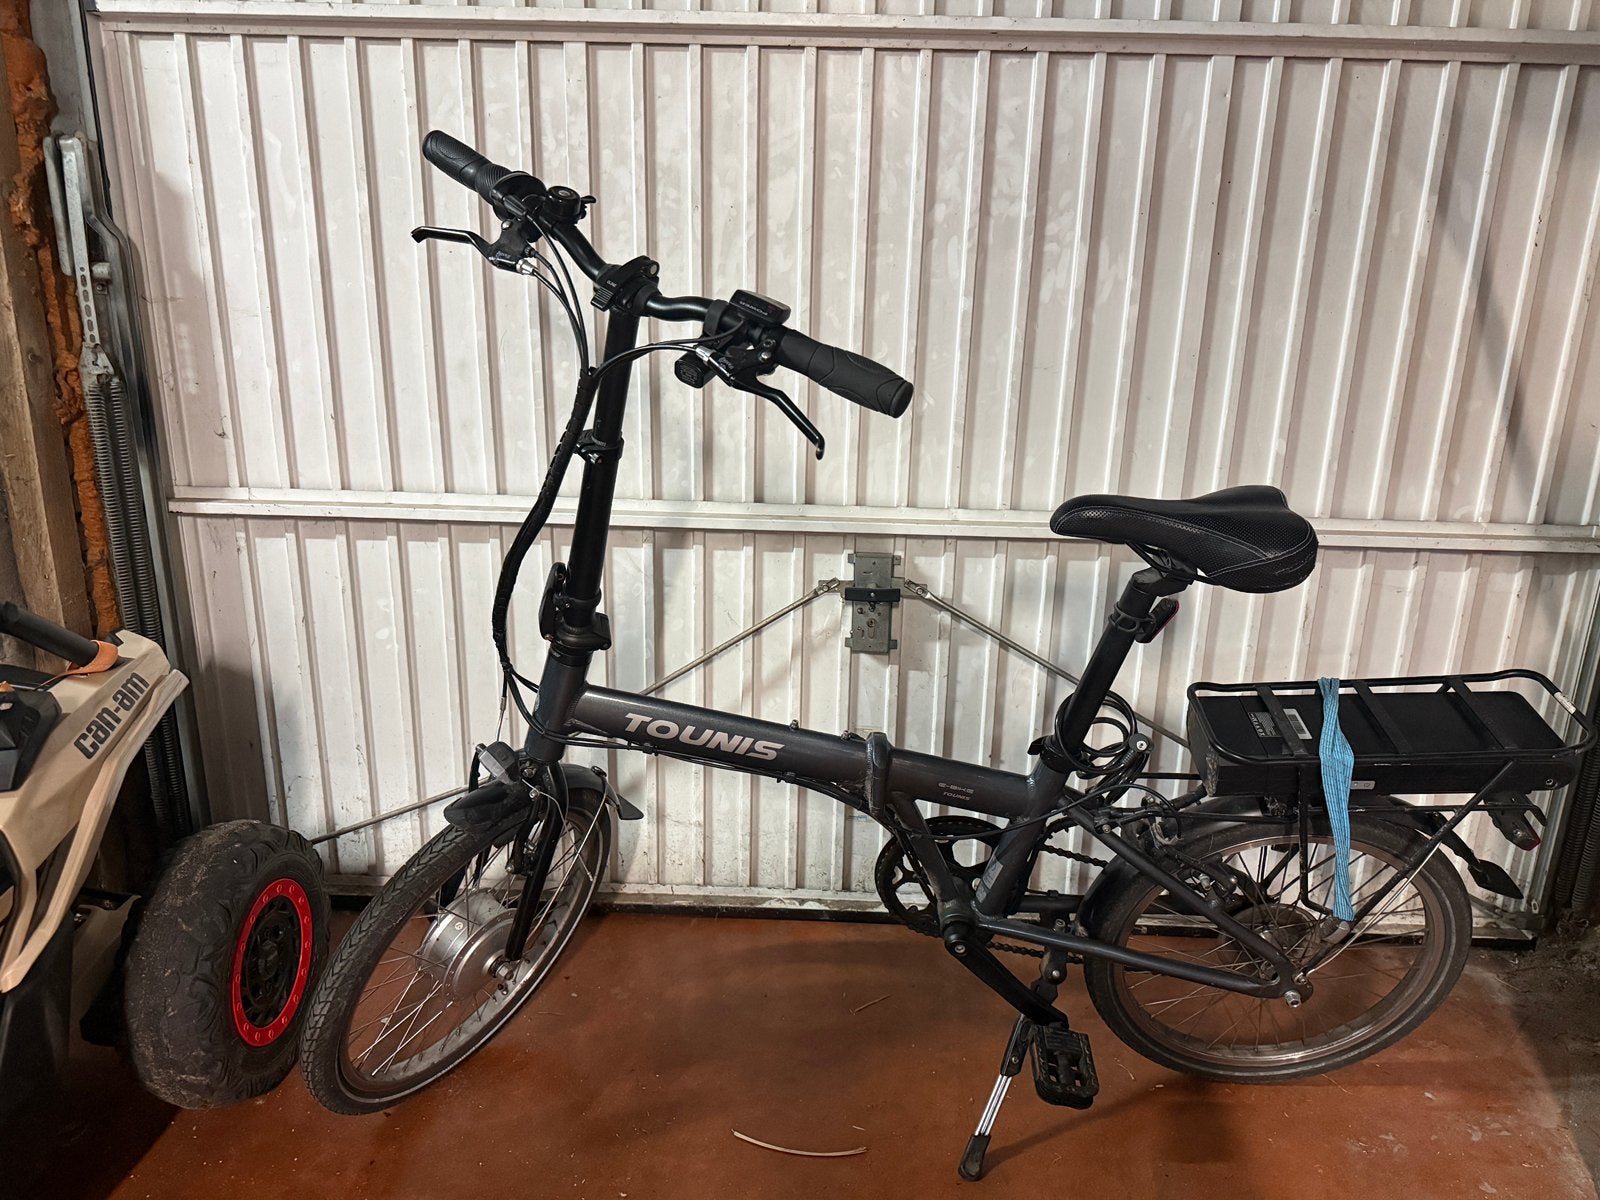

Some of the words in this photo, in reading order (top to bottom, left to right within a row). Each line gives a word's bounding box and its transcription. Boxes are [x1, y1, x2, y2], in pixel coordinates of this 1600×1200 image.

[74, 672, 150, 759] can-am
[625, 712, 785, 761] TOUNIS
[943, 791, 971, 801] TOUNIS
